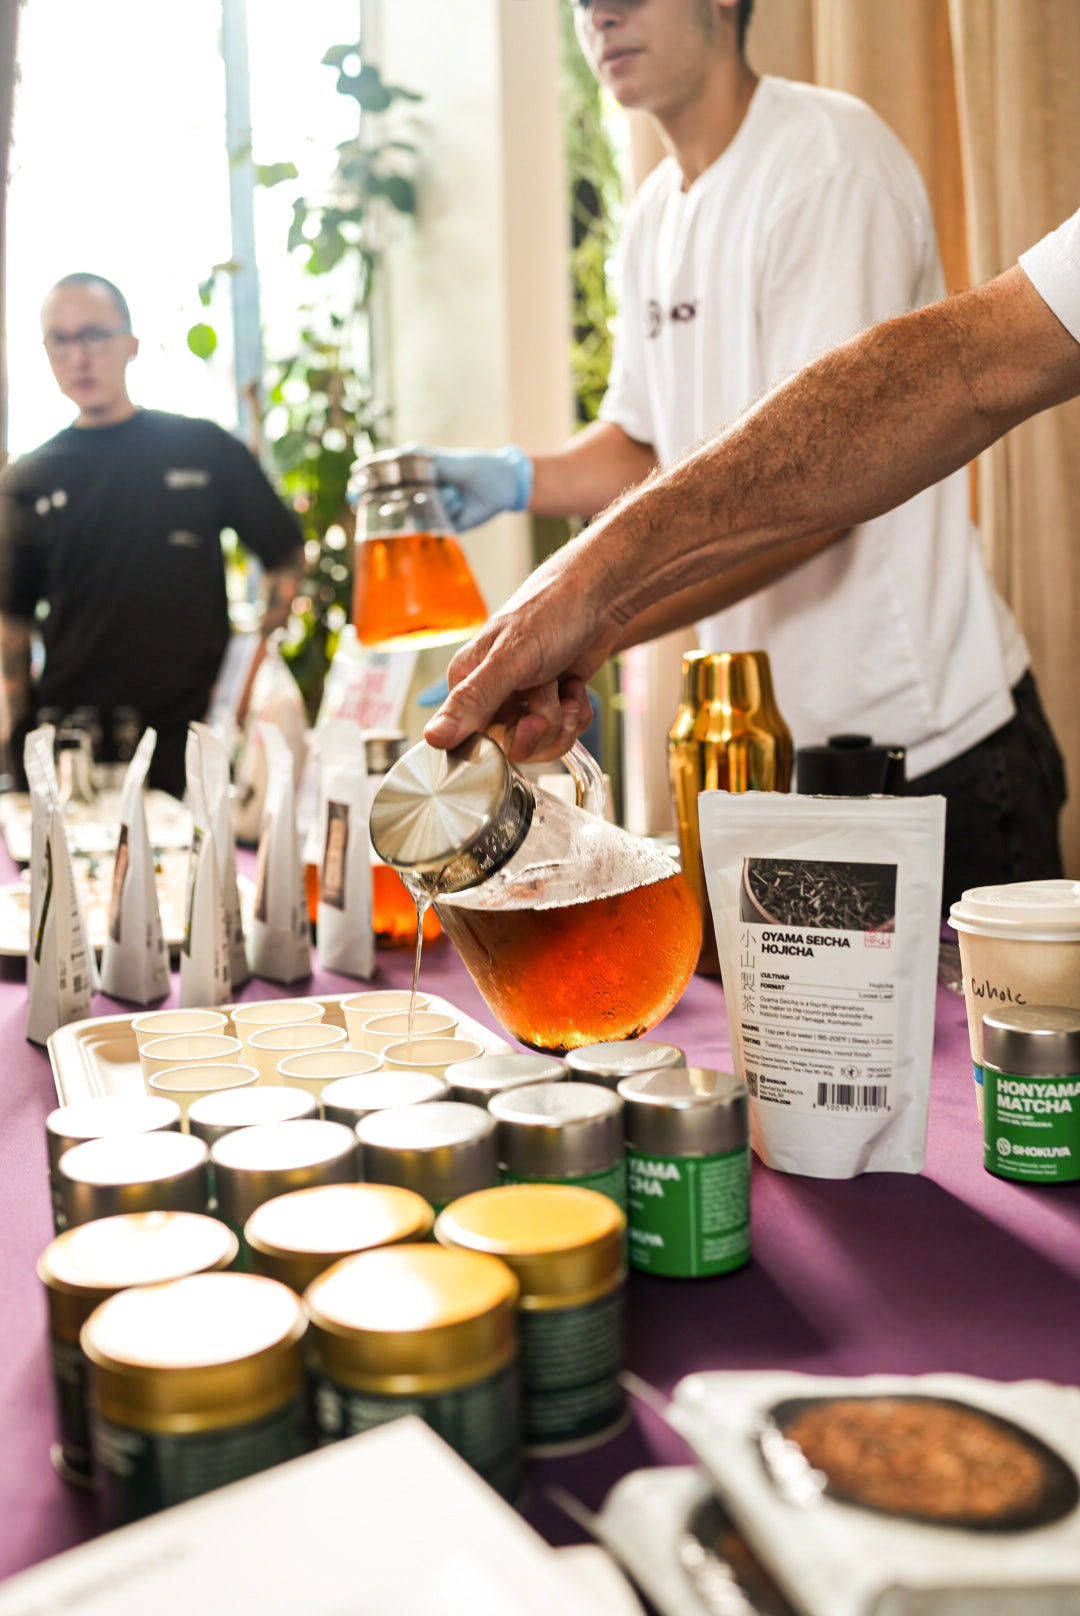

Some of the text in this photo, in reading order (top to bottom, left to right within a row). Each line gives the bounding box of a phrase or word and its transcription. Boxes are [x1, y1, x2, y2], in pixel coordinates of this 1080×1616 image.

[762, 931, 804, 944] OYAMA
[806, 935, 850, 948] SEICHA
[761, 943, 814, 957] HOJICHA
[760, 972, 790, 980] CULTIVAR
[760, 982, 785, 990] FORMAT
[760, 995, 778, 1004] Oyama
[780, 998, 798, 1006] Seicha
[997, 1094, 1073, 1113] MATCHA
[1012, 1144, 1071, 1157] SHOKUYA
